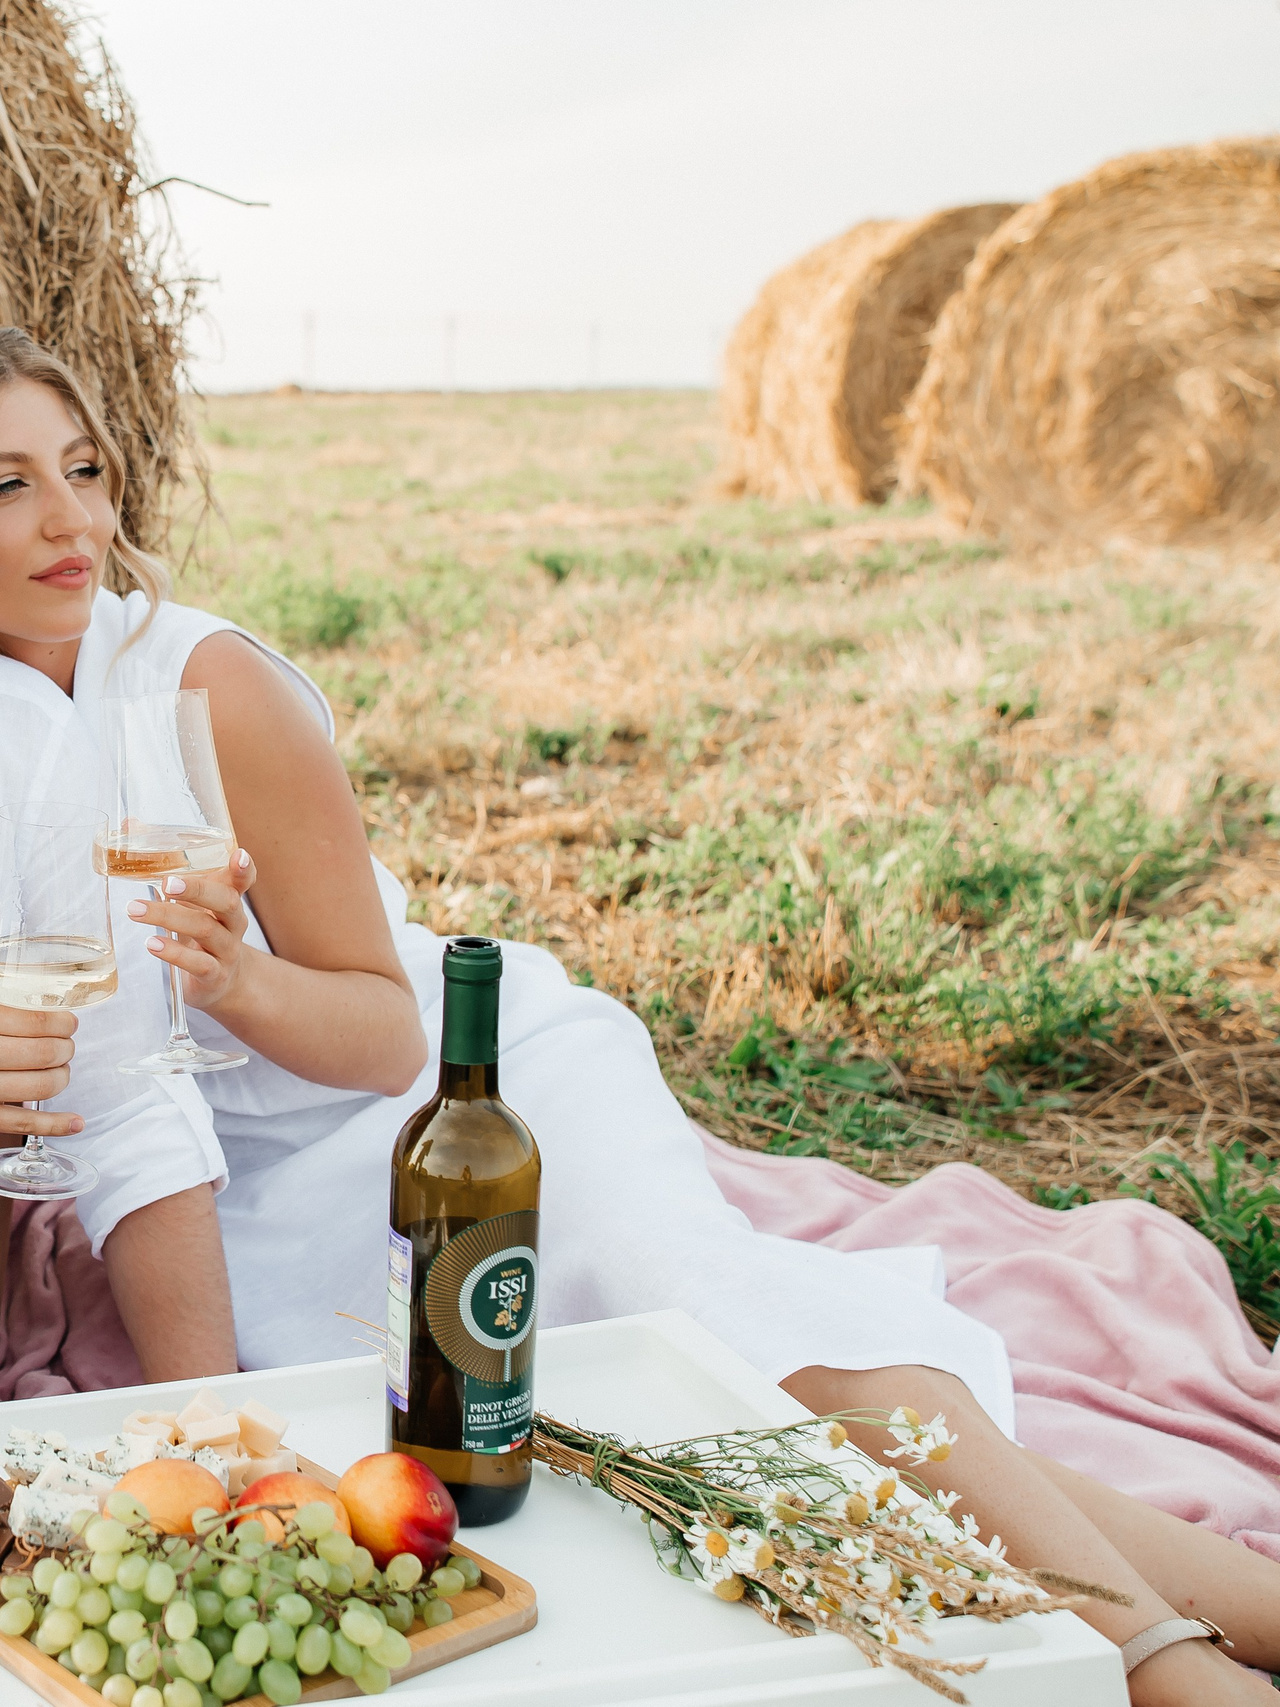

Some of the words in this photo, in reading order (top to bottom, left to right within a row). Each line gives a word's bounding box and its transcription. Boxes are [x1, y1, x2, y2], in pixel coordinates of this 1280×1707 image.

[500, 1267, 522, 1278] WINE
[488, 1274, 527, 1299] ISSI
[469, 1401, 504, 1412] PINOT
[467, 1413, 500, 1424] DELLE
